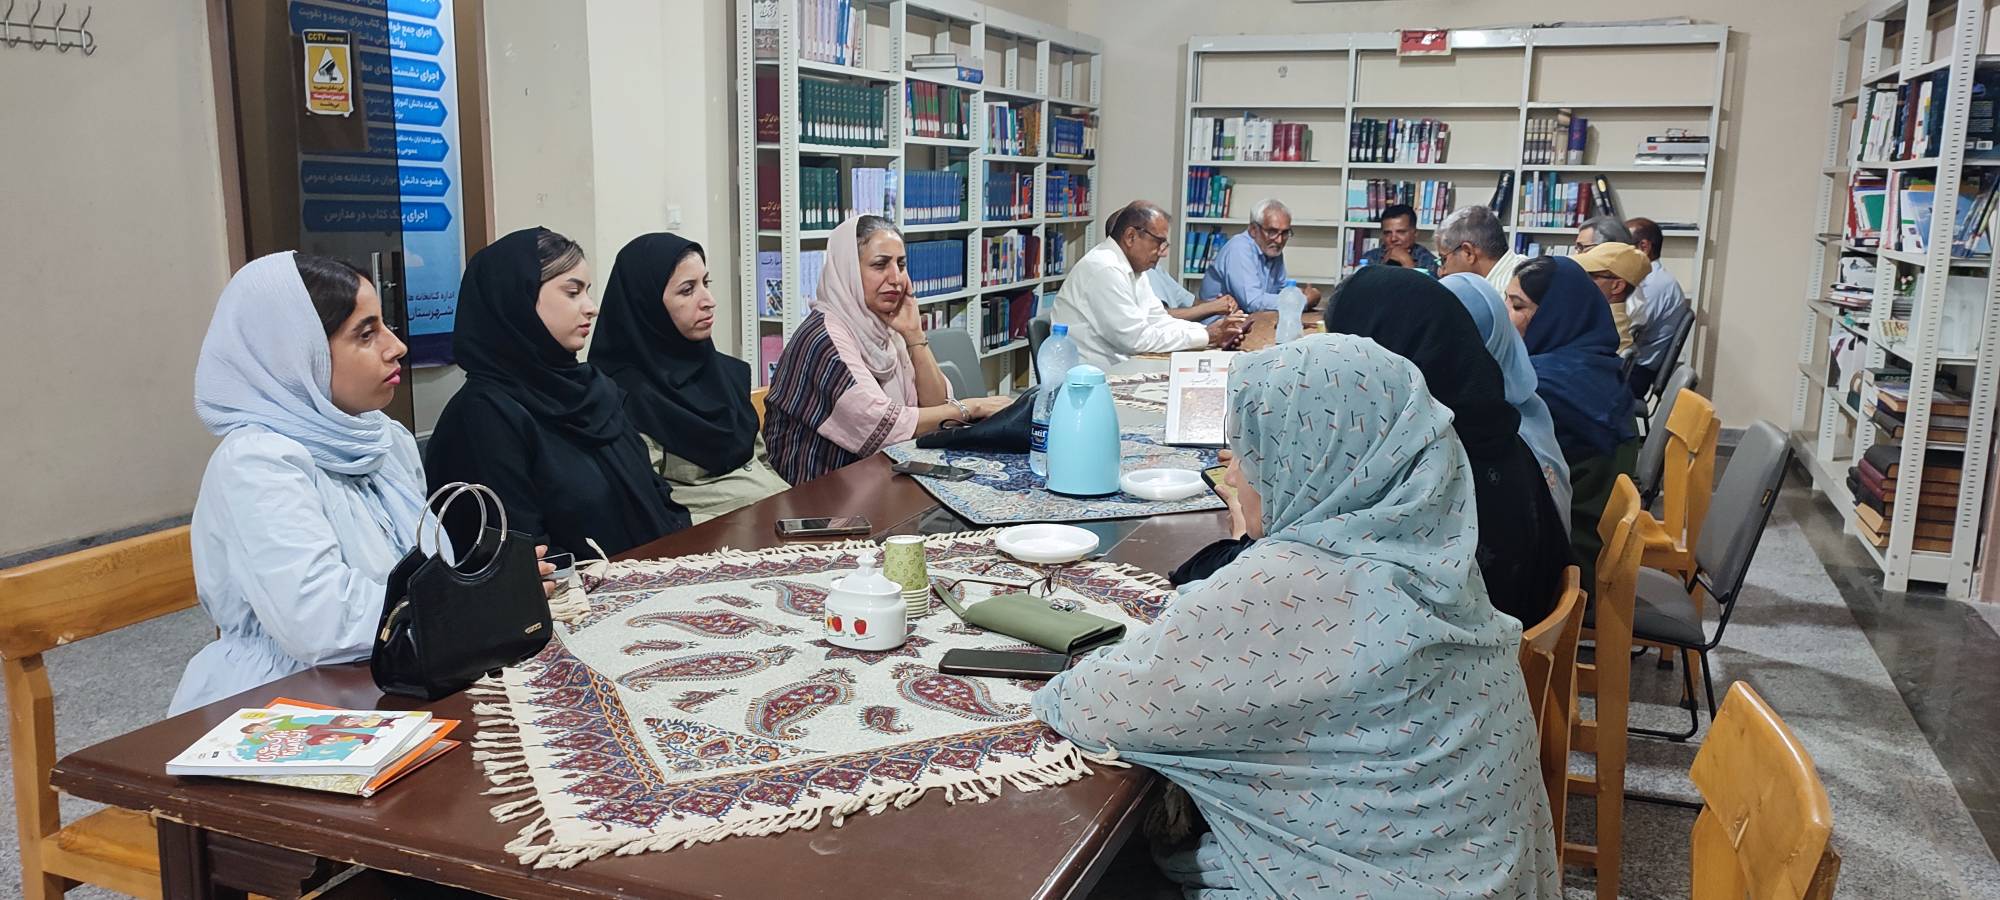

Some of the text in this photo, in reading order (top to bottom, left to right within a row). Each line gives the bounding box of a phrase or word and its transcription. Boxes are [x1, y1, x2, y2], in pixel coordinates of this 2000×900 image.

[307, 32, 327, 41] CCTV
[402, 25, 416, 37] جمع
[416, 26, 433, 39] اجرای
[393, 66, 419, 78] نشست
[420, 70, 440, 83] اجرای
[400, 175, 419, 186] دانش
[420, 177, 444, 188] عضویت
[324, 207, 355, 223] مدارس
[367, 208, 387, 220] کتاب
[406, 209, 428, 223] اجرای
